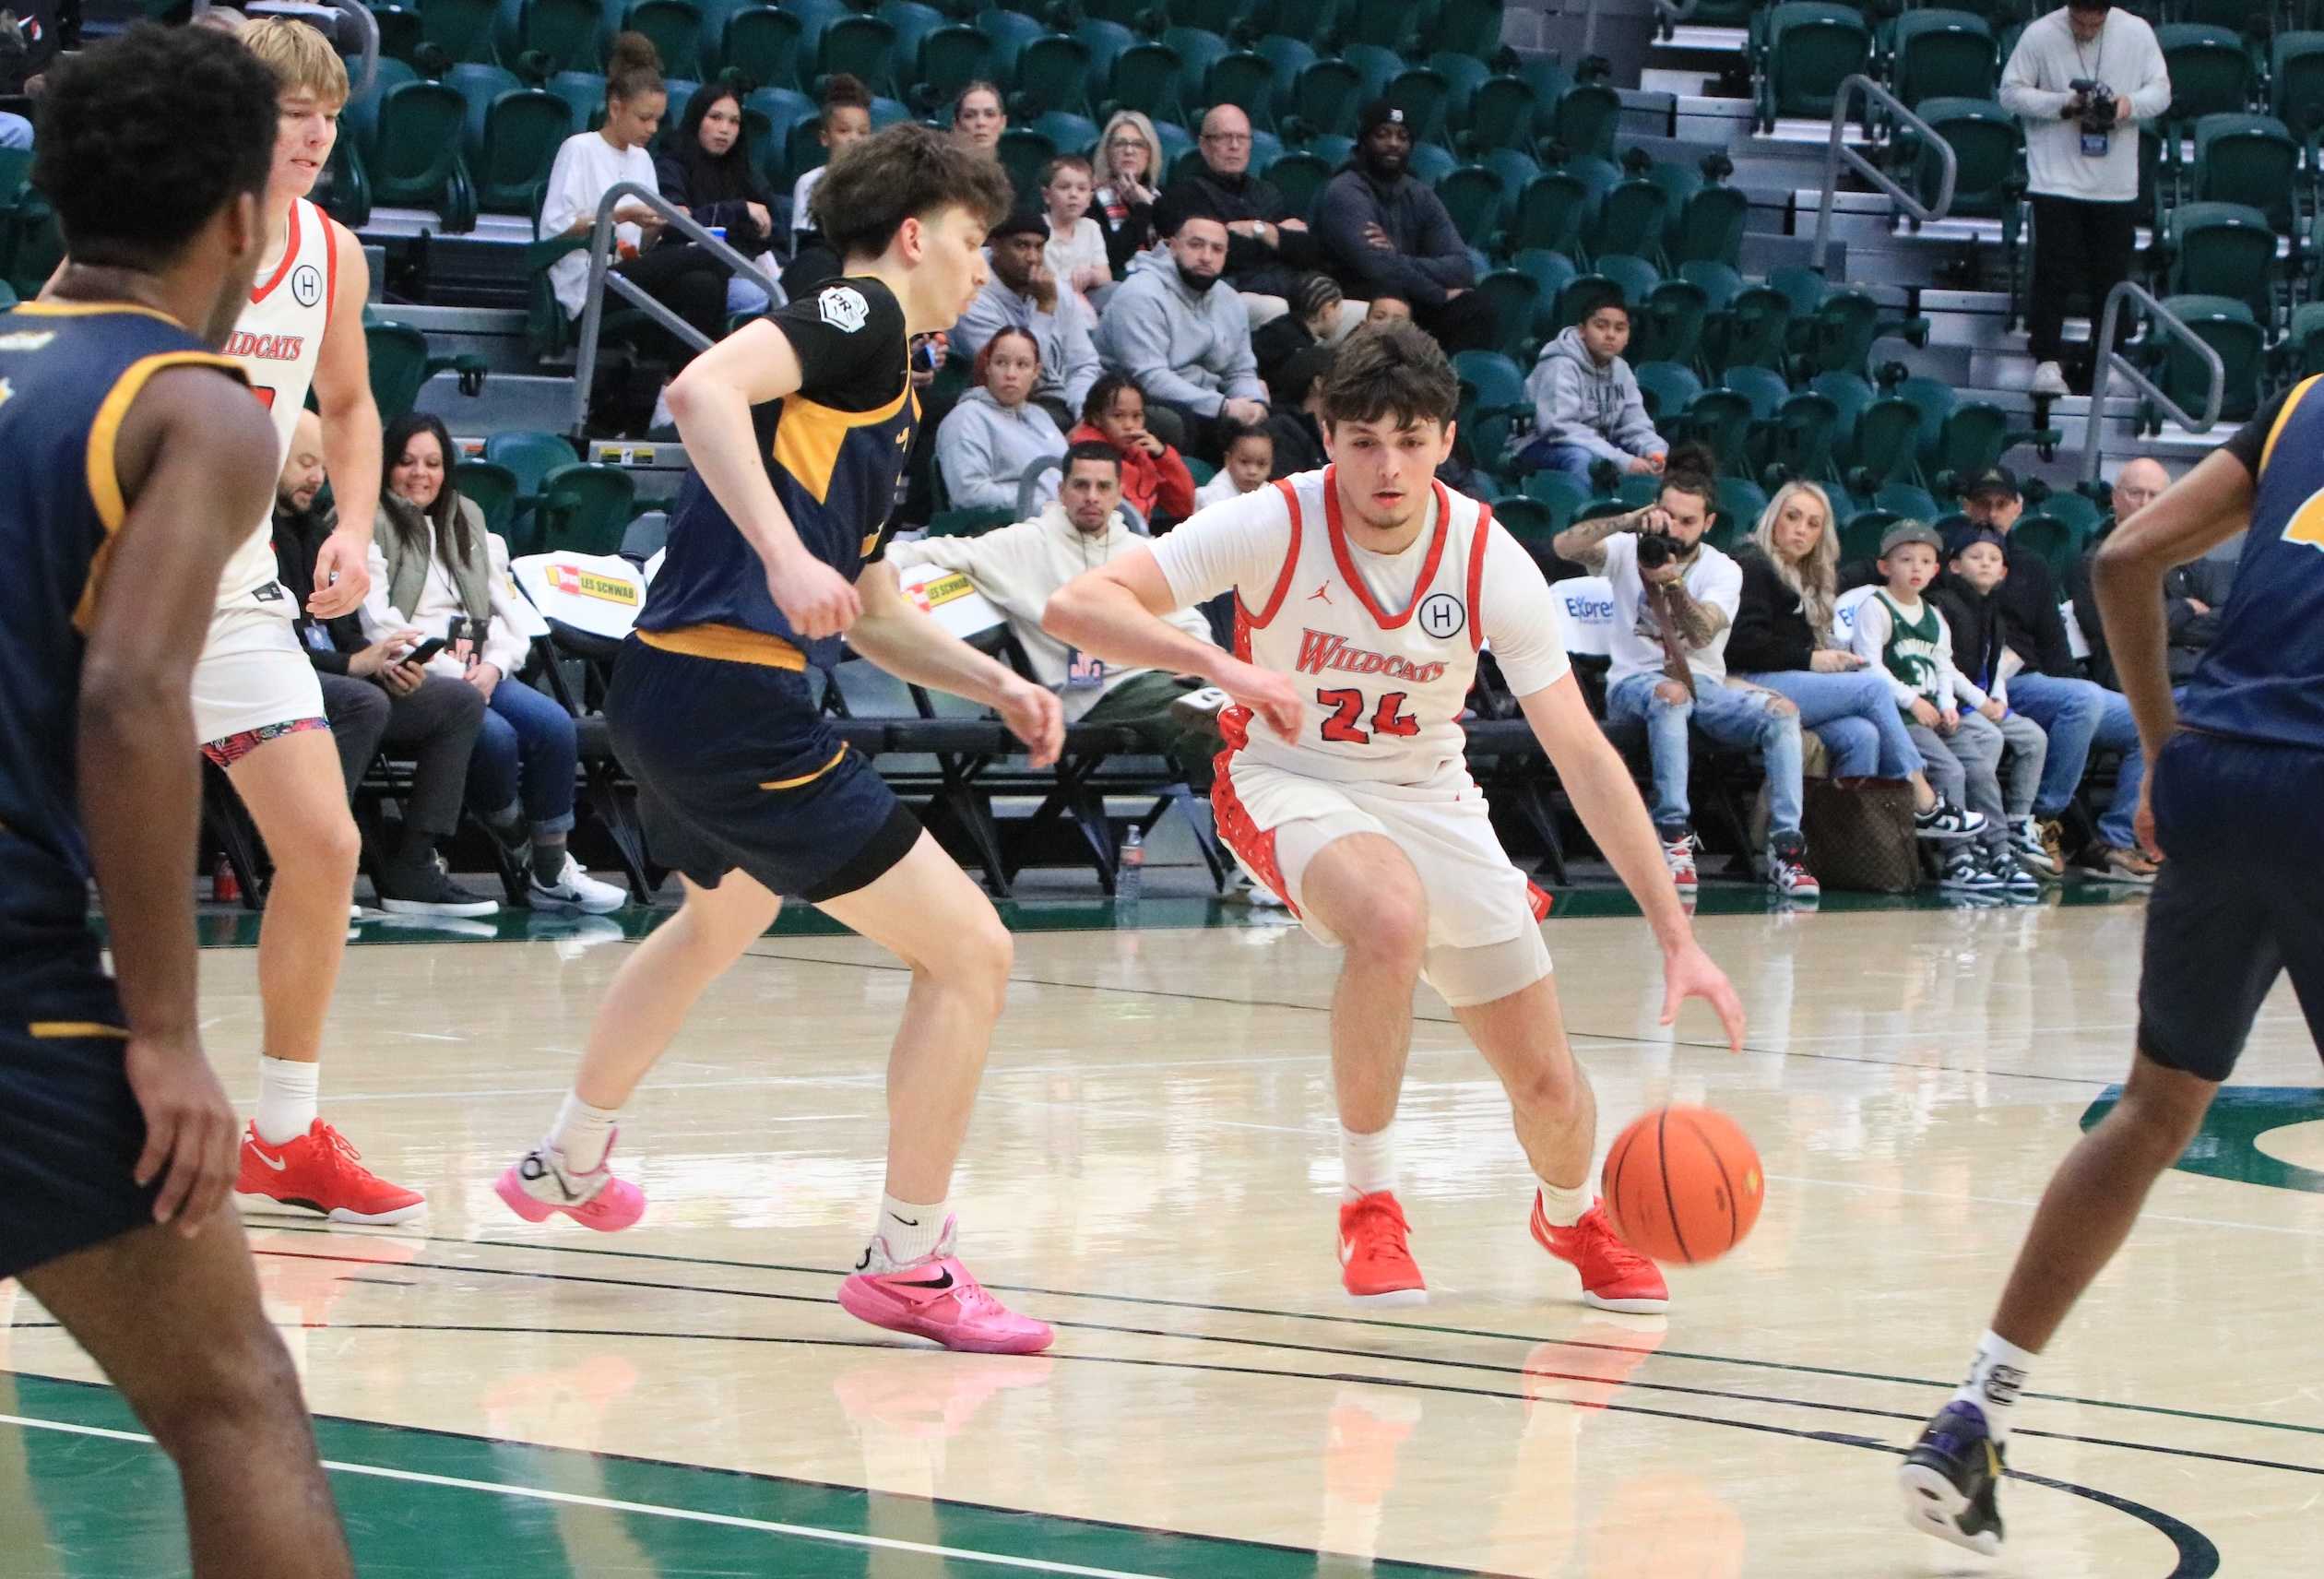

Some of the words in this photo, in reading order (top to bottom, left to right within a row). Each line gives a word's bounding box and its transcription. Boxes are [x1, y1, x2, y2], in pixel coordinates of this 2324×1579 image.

[302, 274, 314, 298] H
[220, 331, 304, 361] ILDCATS
[581, 576, 595, 591] LES
[597, 580, 634, 599] SCHWAB
[1433, 604, 1452, 628] H
